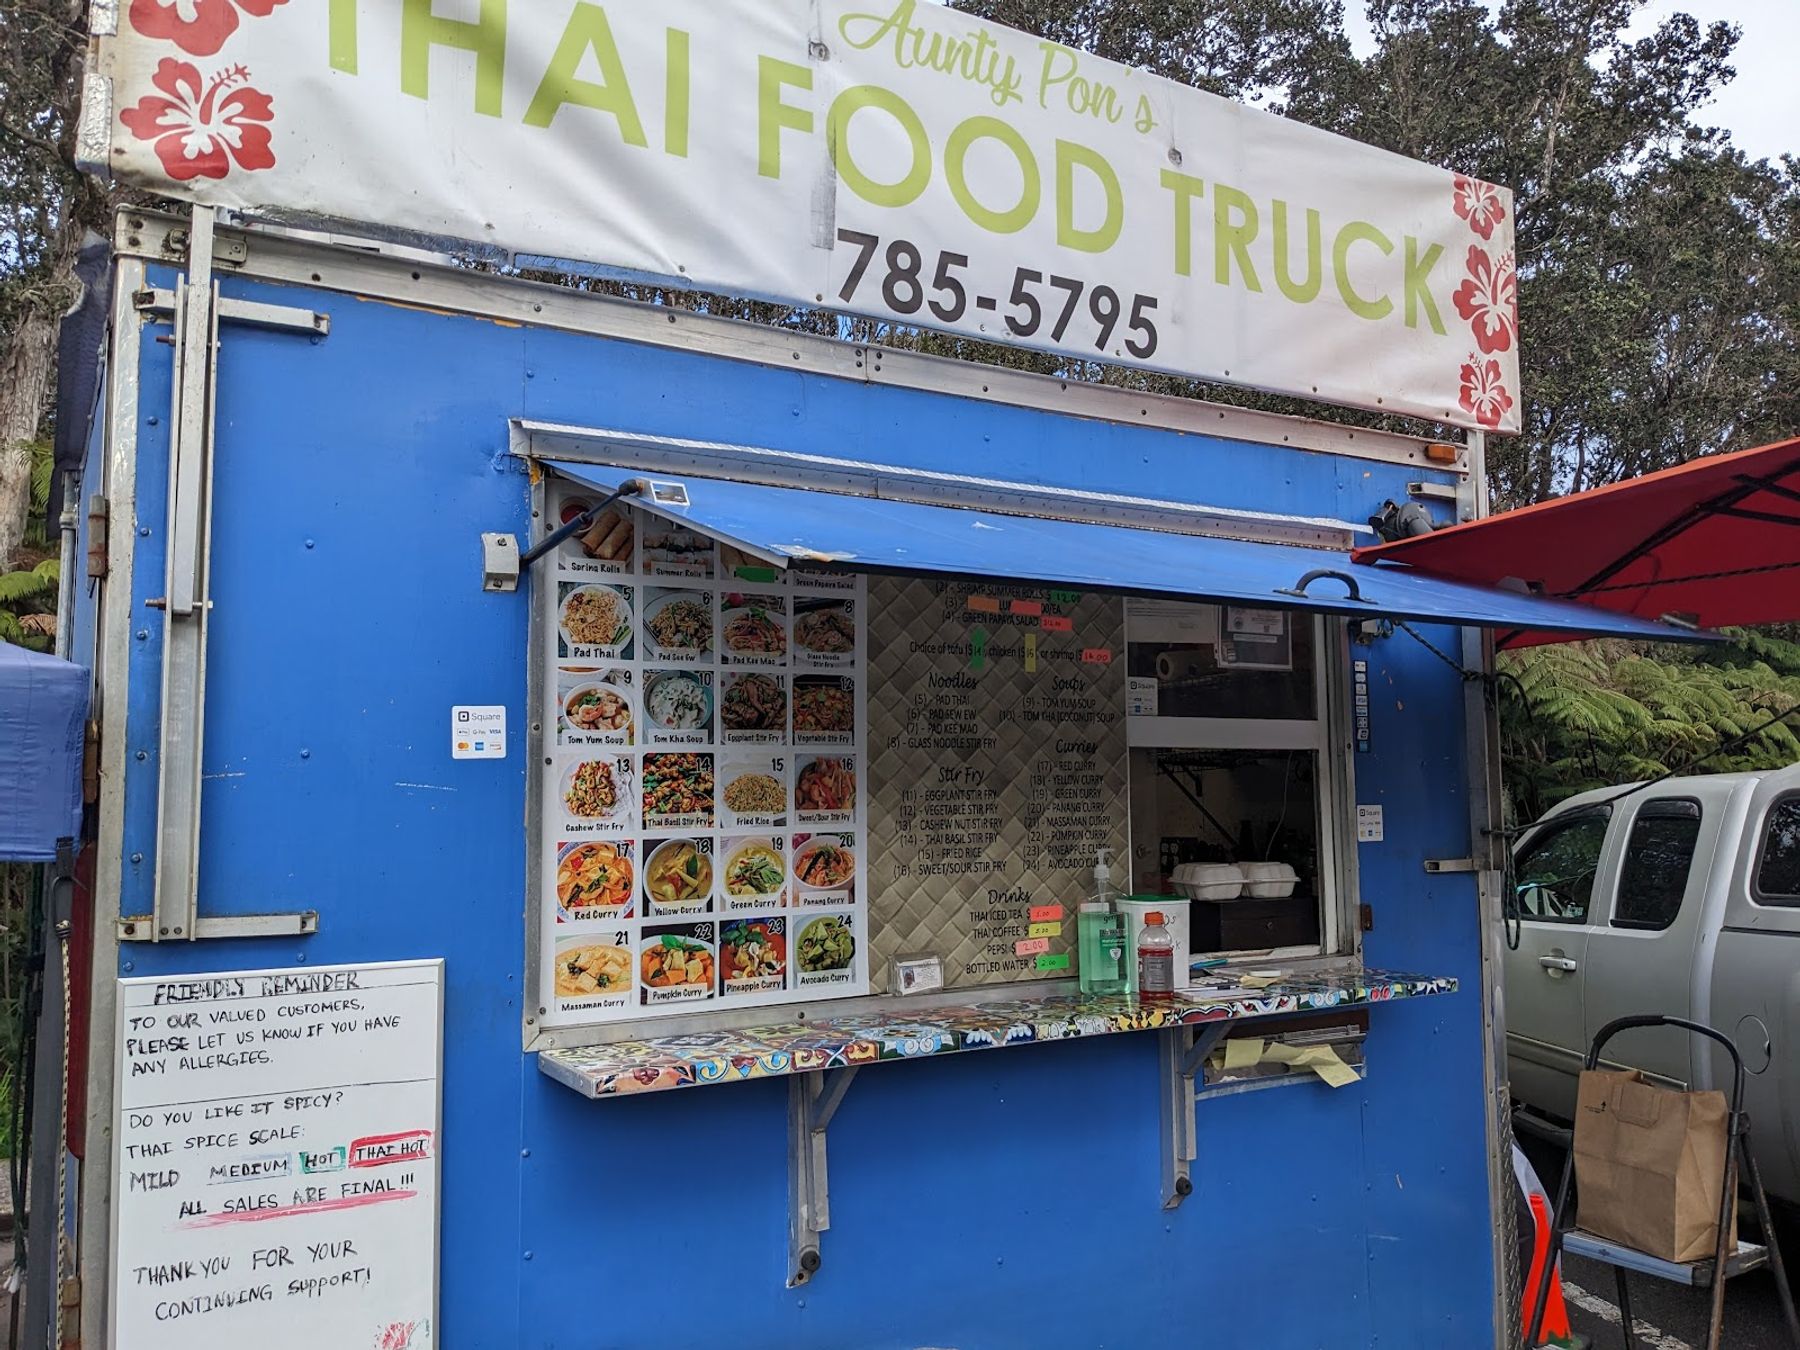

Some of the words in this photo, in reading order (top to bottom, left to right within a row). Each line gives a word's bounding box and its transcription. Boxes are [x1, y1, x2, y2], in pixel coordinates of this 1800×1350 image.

[838, 0, 1022, 106] Aunty
[1039, 42, 1158, 134] Pon's
[758, 54, 1124, 254] FOOD
[1160, 168, 1447, 336] TRUCK
[837, 228, 1157, 359] 785-5795
[601, 564, 620, 574] Rolls
[574, 647, 590, 658] Pad
[593, 648, 615, 659] Thai
[699, 672, 711, 685] 10
[775, 674, 785, 687] 11
[928, 672, 980, 689] Noodles
[1052, 675, 1086, 694] Soups
[472, 713, 501, 722] Square
[567, 736, 582, 744] Tom
[583, 735, 601, 744] Yum
[602, 735, 624, 745] Soup
[654, 735, 667, 743] Tom
[669, 735, 682, 743] Kha
[1055, 739, 1098, 754] Curries
[616, 758, 630, 773] 13
[696, 757, 710, 772] 14
[771, 758, 784, 771] 15
[841, 759, 853, 771] 16
[938, 767, 963, 785] Stir
[965, 767, 985, 786] Fry
[902, 790, 917, 803] (11)
[925, 790, 965, 801] EGGPLANT
[984, 790, 997, 800] FRY
[899, 805, 916, 817] (12)
[924, 804, 966, 816] VEGETABLE
[967, 804, 984, 815] STIR
[985, 804, 998, 815] FRY
[565, 822, 594, 832] Cashew
[596, 822, 610, 832] Stir
[611, 821, 625, 833] Fry
[920, 819, 952, 831] CASHEW
[953, 819, 971, 830] NUT
[989, 818, 1002, 829] FRY
[1047, 816, 1088, 827] MASSAMAN
[1088, 815, 1110, 827] CURRY
[839, 834, 853, 848] 20
[944, 833, 966, 844] BASIL
[967, 833, 984, 844] STIR
[985, 833, 999, 844] FRY
[1027, 829, 1044, 843] (22)
[616, 843, 630, 857] 17
[695, 840, 710, 854] 18
[771, 837, 784, 850] 19
[965, 847, 982, 858] RICE
[918, 862, 972, 876] SWEET/SOUR
[973, 861, 992, 873] STIR
[992, 860, 1006, 872] FRY
[827, 896, 845, 905] Curry
[988, 887, 1032, 904] Drinks
[680, 905, 702, 915] Curry
[730, 900, 752, 909] Green
[752, 899, 777, 909] Curry
[574, 910, 590, 920] Red
[592, 909, 618, 921] Curry
[837, 915, 852, 928] 24
[970, 911, 988, 922] THAI
[989, 910, 1007, 921] ICED
[1008, 909, 1023, 919] TEA
[694, 924, 712, 940] 22
[768, 919, 783, 934] 23
[992, 926, 1020, 937] COFFEE
[615, 931, 629, 946] 21
[1022, 940, 1044, 951] 2.00
[966, 961, 1000, 974] BOTTLED
[1002, 960, 1029, 971] WATER
[726, 981, 760, 994] Pineapple
[762, 978, 781, 990] Curry
[800, 974, 828, 985] Avocado
[829, 973, 849, 983] Curry
[154, 978, 246, 1005] FRIENDLY
[261, 971, 360, 997] REMINDER
[652, 989, 682, 1001] Pumpkin
[684, 987, 703, 999] Curry
[561, 1001, 600, 1012] Massaman
[601, 1000, 625, 1011] Curry
[130, 1016, 155, 1031] TO
[167, 1013, 202, 1029] OUR
[209, 1008, 266, 1024] VALUED
[277, 998, 366, 1018] CUSTOMERS,
[126, 1038, 190, 1057] PLEASE
[198, 1032, 226, 1050] LET
[236, 1031, 255, 1044] US
[262, 1026, 303, 1042] KNOW
[307, 1022, 325, 1037] IF
[331, 1018, 357, 1035] YOU
[364, 1015, 401, 1031] HAVE
[131, 1059, 167, 1077] ANY
[179, 1050, 274, 1071] ALLERGIES.
[130, 1114, 154, 1129] DO
[164, 1110, 193, 1126] YOU
[205, 1103, 243, 1119] LIKE
[250, 1101, 274, 1115] IT
[283, 1091, 344, 1111] SPICY?
[126, 1141, 173, 1160] THAI
[184, 1133, 239, 1150] SPICE
[248, 1126, 306, 1146] SCALE:
[129, 1171, 180, 1192] MILD
[209, 1160, 288, 1179] MEDIUM
[304, 1151, 336, 1168] HOT
[356, 1144, 396, 1161] THAI
[400, 1138, 428, 1156] HOT
[178, 1200, 208, 1219] ALL
[222, 1193, 279, 1214] SALES
[292, 1187, 328, 1206] ARE
[252, 1245, 295, 1271] FOR
[306, 1239, 358, 1263] YOUR
[155, 1283, 273, 1321] CONTINUING
